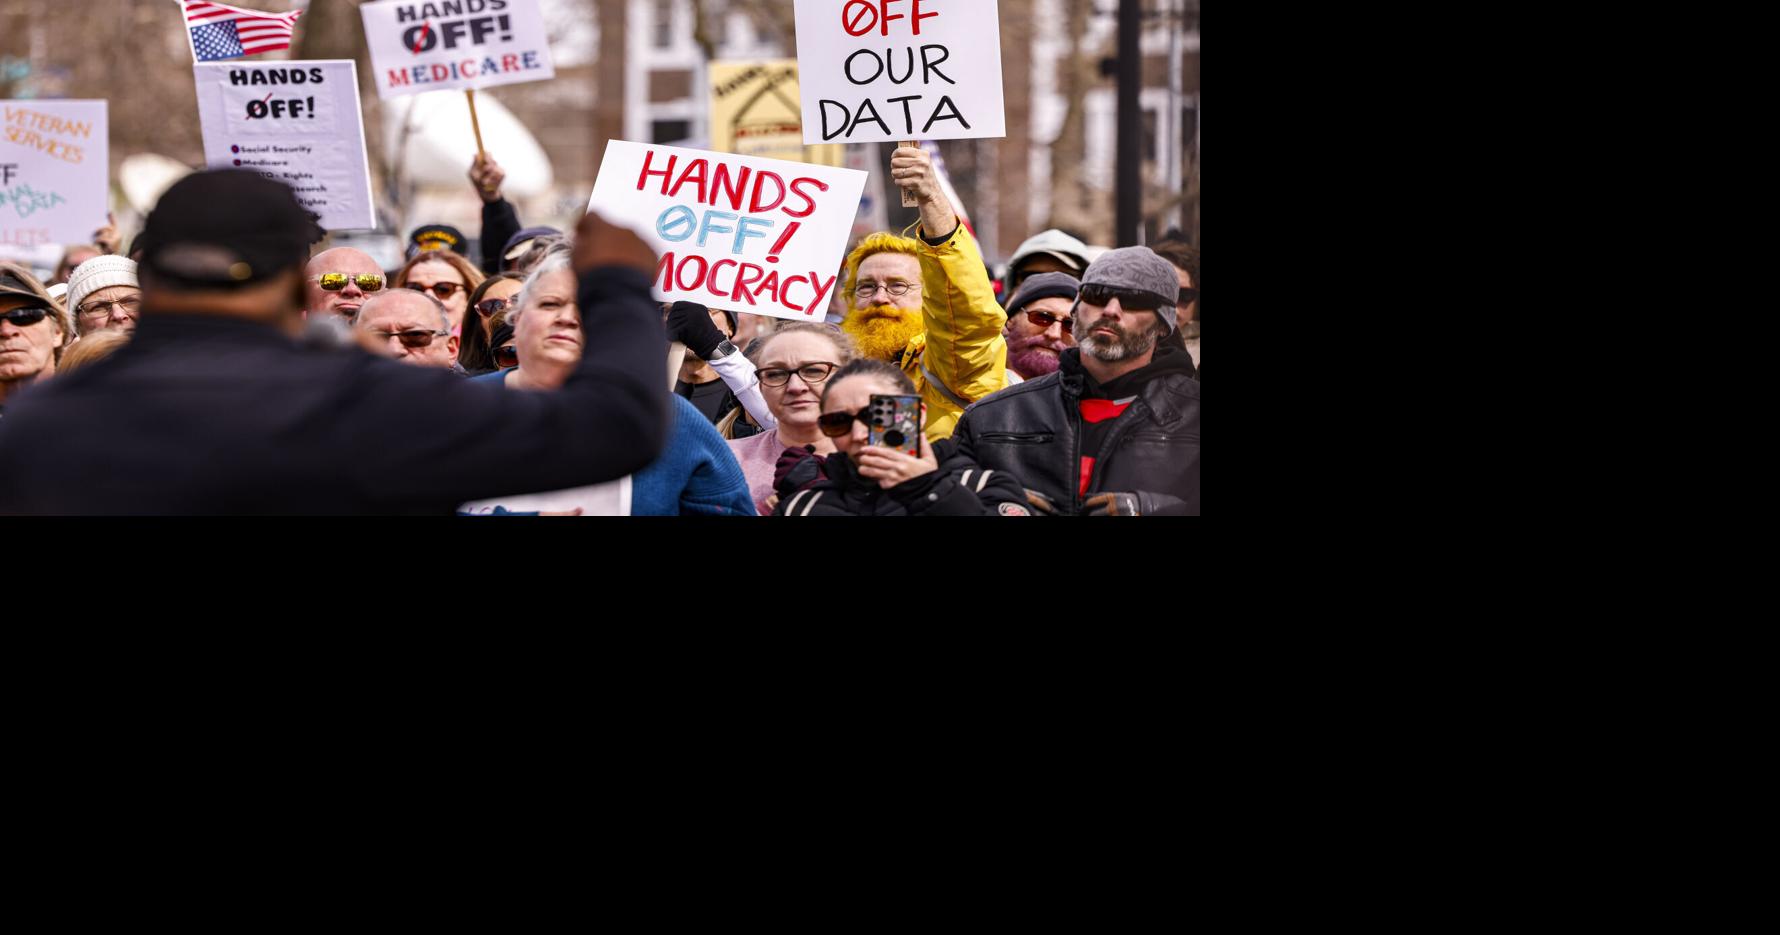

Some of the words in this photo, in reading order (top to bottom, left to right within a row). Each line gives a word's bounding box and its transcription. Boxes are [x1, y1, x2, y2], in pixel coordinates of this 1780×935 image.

[396, 0, 507, 22] HANDS
[229, 68, 324, 85] HANDS
[388, 51, 541, 87] MEDICARE
[844, 44, 955, 85] OUR
[5, 106, 93, 139] VETERAN
[819, 95, 971, 141] DATA
[5, 126, 84, 164] SERVICES
[241, 146, 269, 156] Social
[273, 146, 312, 158] Security
[637, 150, 829, 217] HANDS
